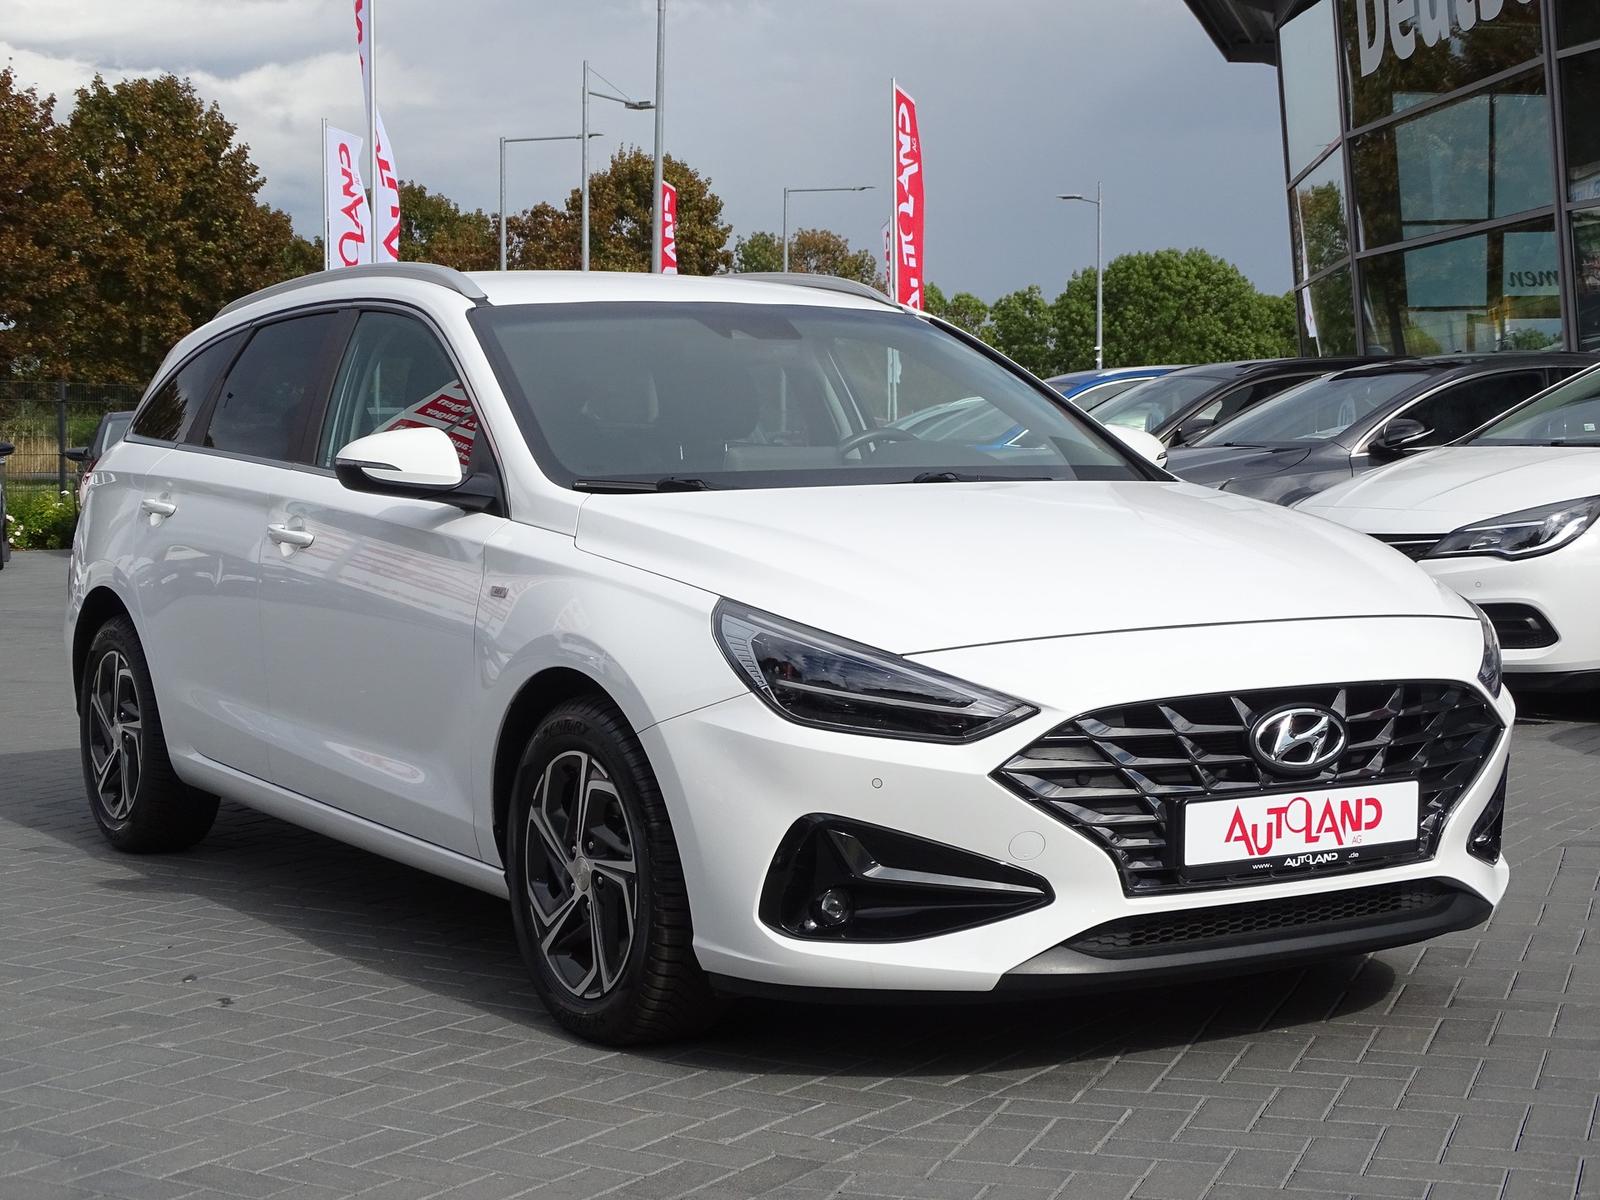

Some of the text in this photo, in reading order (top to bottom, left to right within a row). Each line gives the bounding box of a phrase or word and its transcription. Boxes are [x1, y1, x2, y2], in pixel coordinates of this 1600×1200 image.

[1224, 797, 1382, 855] AUTOLAND
[1351, 834, 1362, 845] AG
[1284, 853, 1338, 867] AUTOLAND
